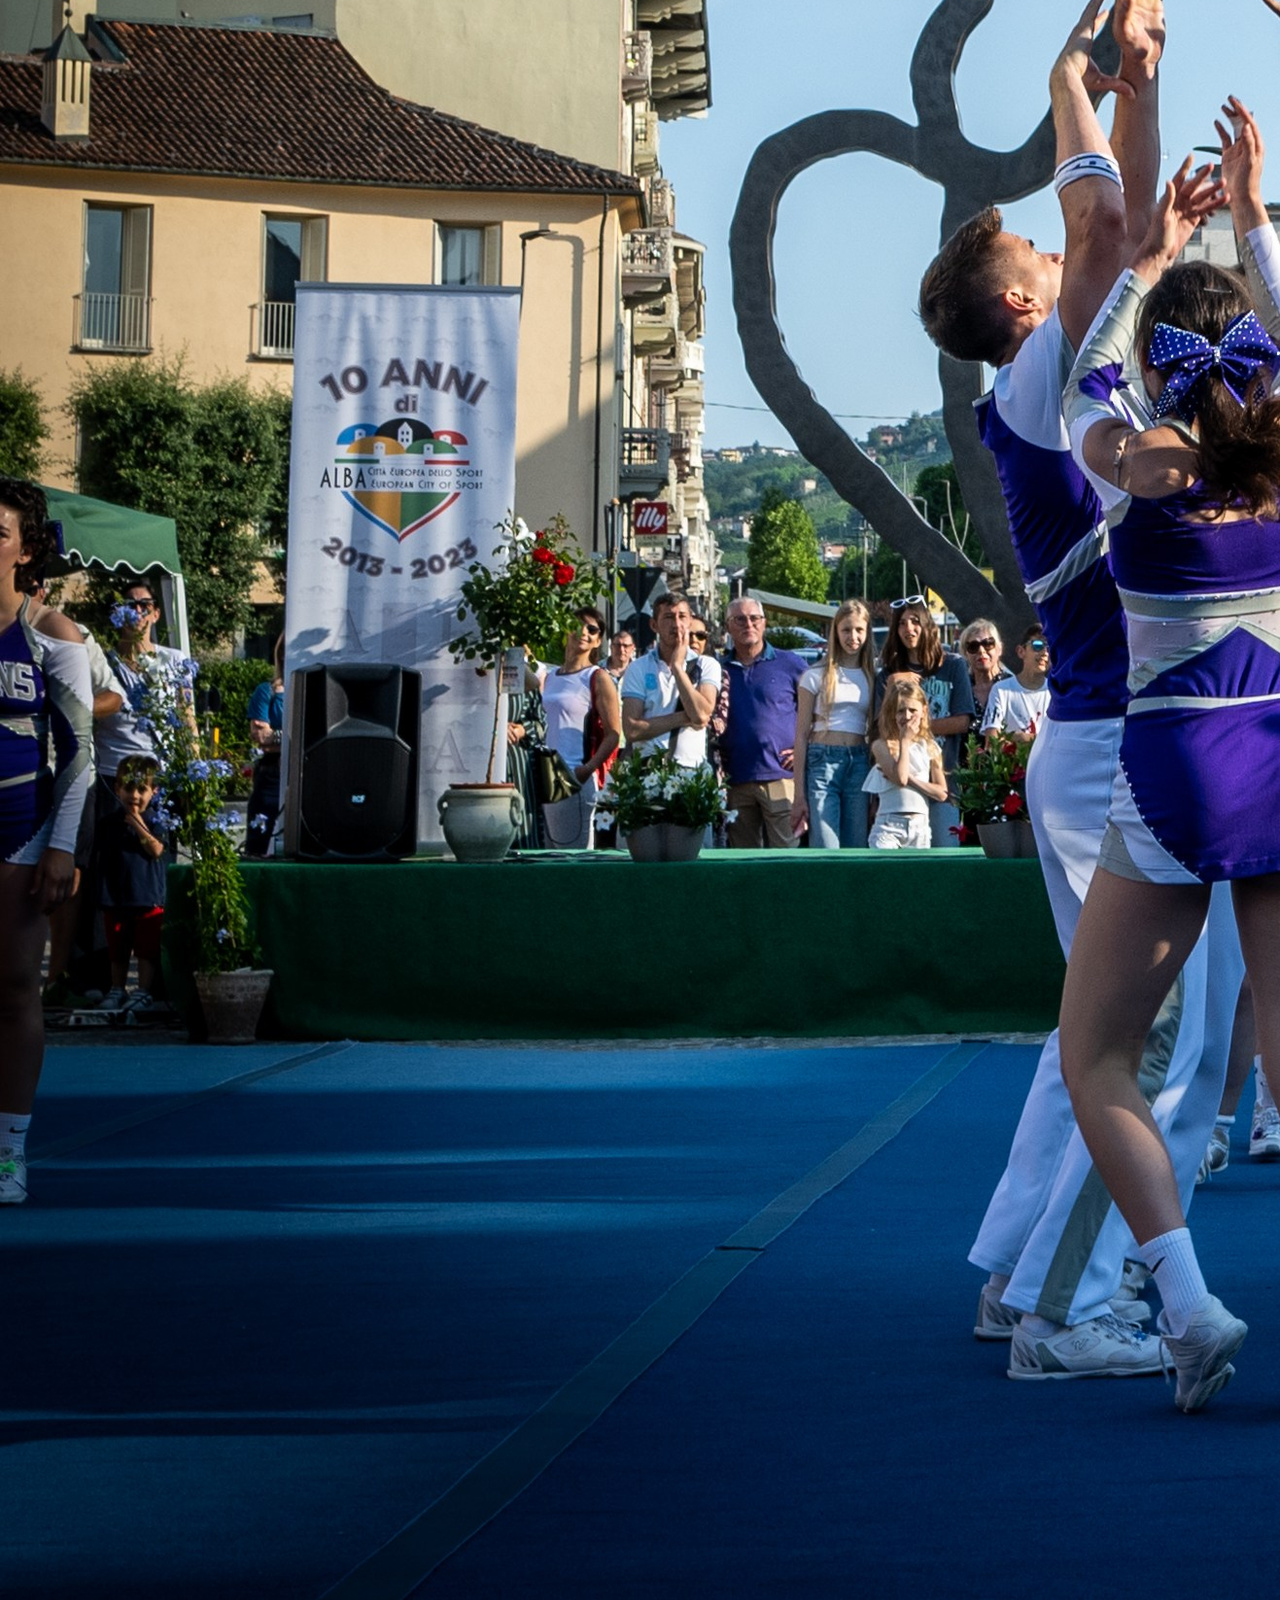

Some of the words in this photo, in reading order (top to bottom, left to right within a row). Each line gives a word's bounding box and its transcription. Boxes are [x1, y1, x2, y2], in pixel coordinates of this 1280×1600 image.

[319, 366, 368, 403] 10
[380, 358, 489, 406] ANNI
[395, 394, 417, 414] di
[320, 467, 367, 489] ALBA
[636, 506, 666, 532] illy
[321, 537, 385, 577] 2013
[410, 537, 478, 580] 2023
